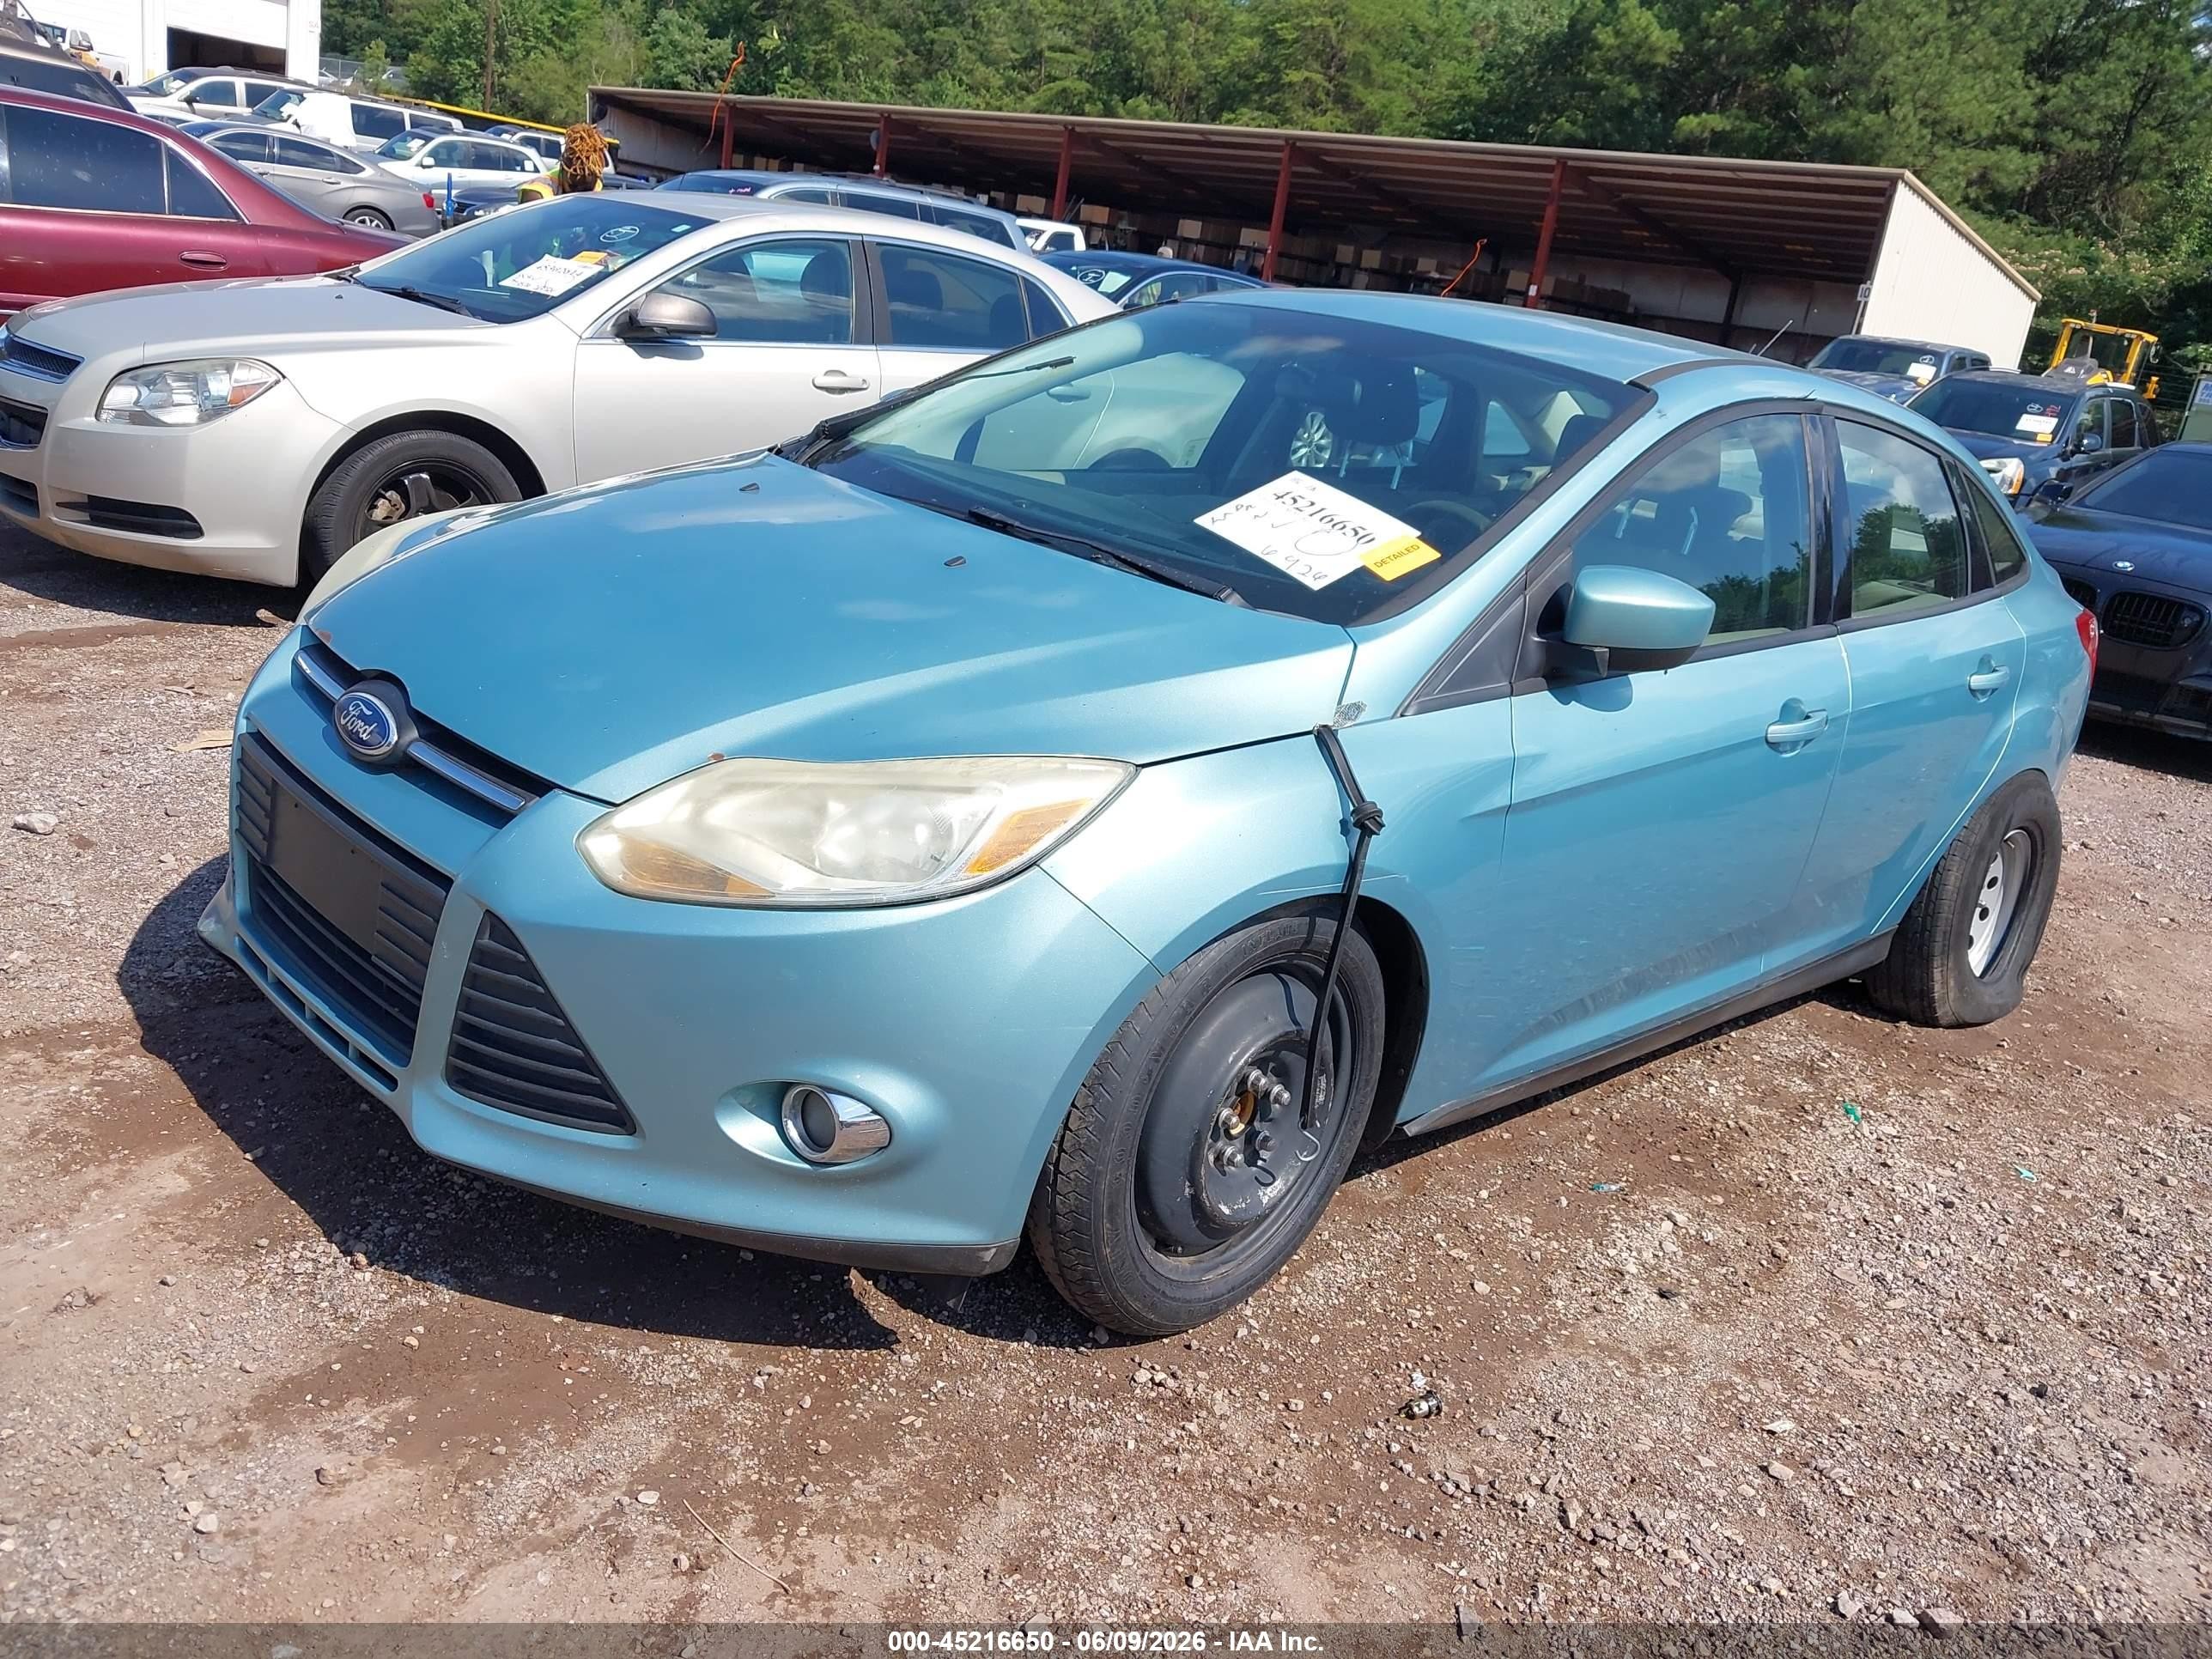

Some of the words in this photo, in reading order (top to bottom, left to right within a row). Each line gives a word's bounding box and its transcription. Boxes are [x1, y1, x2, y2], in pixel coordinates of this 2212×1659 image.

[1860, 287, 1871, 299] 10
[1273, 490, 1376, 546] 45216650
[1373, 544, 1420, 569] DETAILED
[340, 701, 378, 740] Ford
